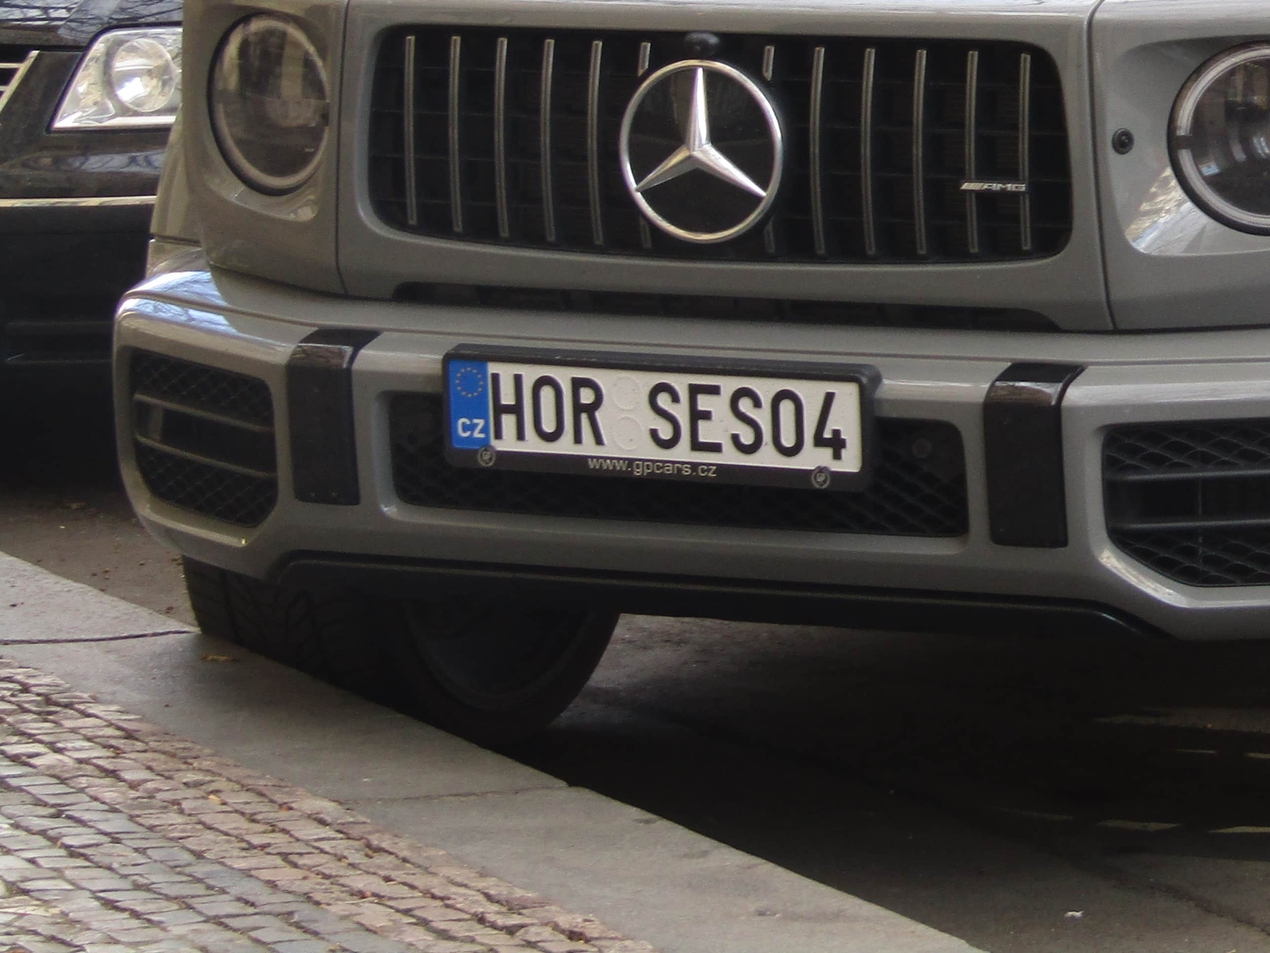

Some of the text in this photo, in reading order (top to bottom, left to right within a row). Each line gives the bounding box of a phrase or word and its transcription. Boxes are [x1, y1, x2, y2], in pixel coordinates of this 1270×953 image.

[983, 183, 1025, 192] AMG
[457, 417, 486, 439] CZ
[587, 457, 718, 479] www.gpcars.cz
